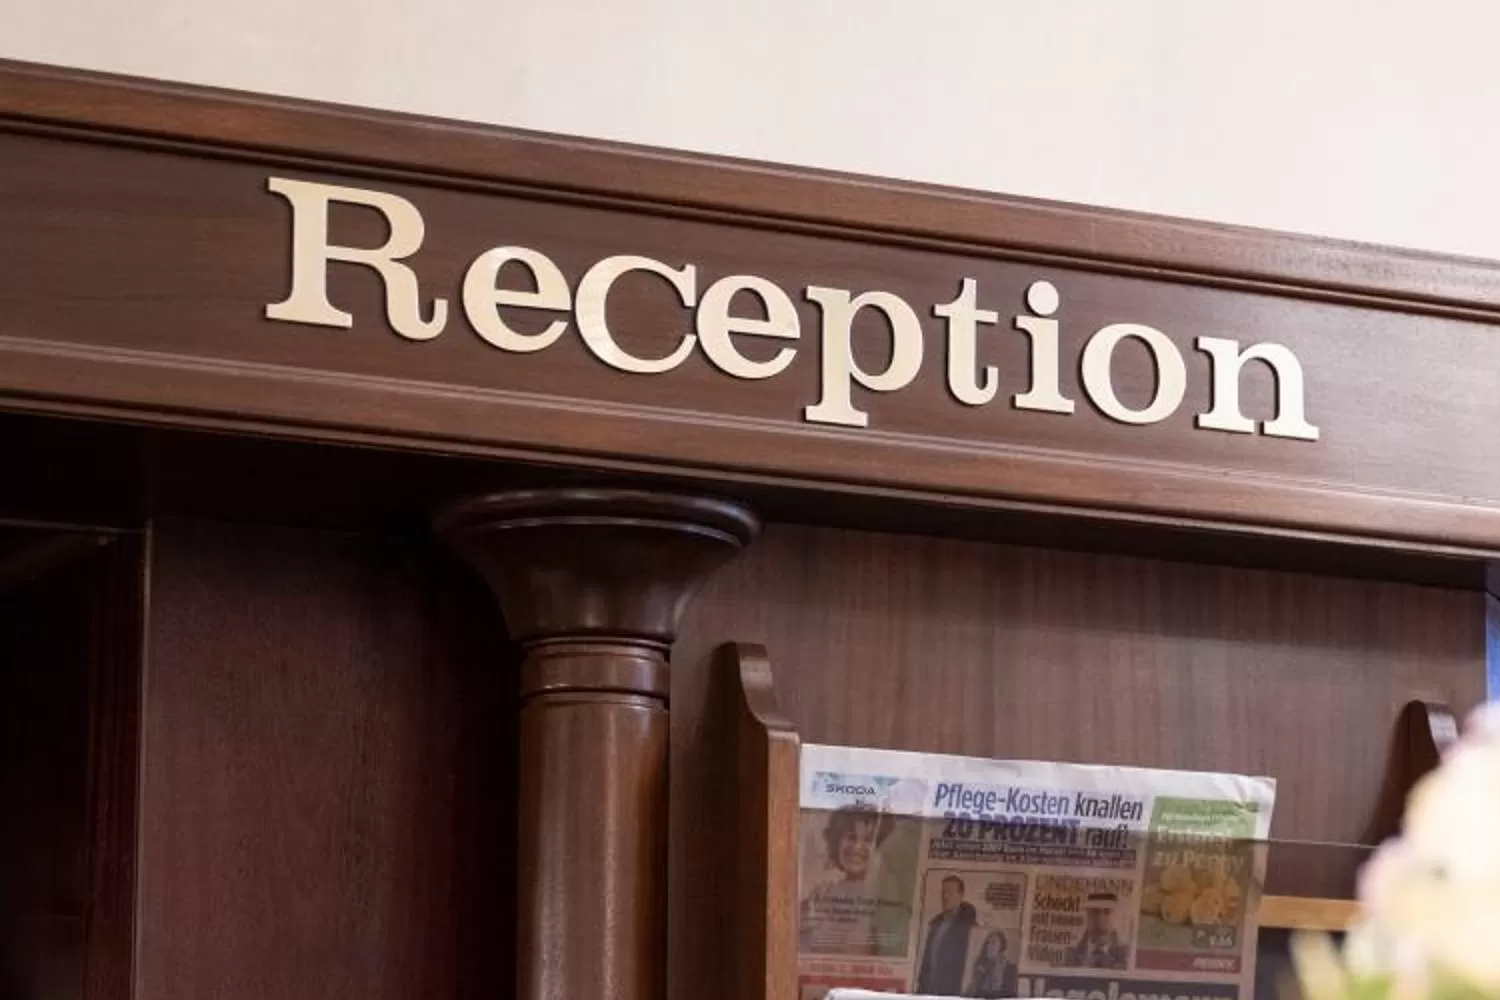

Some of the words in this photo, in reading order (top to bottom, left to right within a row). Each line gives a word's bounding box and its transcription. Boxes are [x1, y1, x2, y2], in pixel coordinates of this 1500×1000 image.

[265, 177, 1320, 440] Reception
[934, 783, 1069, 815] Pflege-Kosten
[1073, 792, 1143, 820] knallen
[942, 811, 971, 839] 20
[978, 813, 1080, 845] PROZENT
[1084, 823, 1129, 849] rauf!
